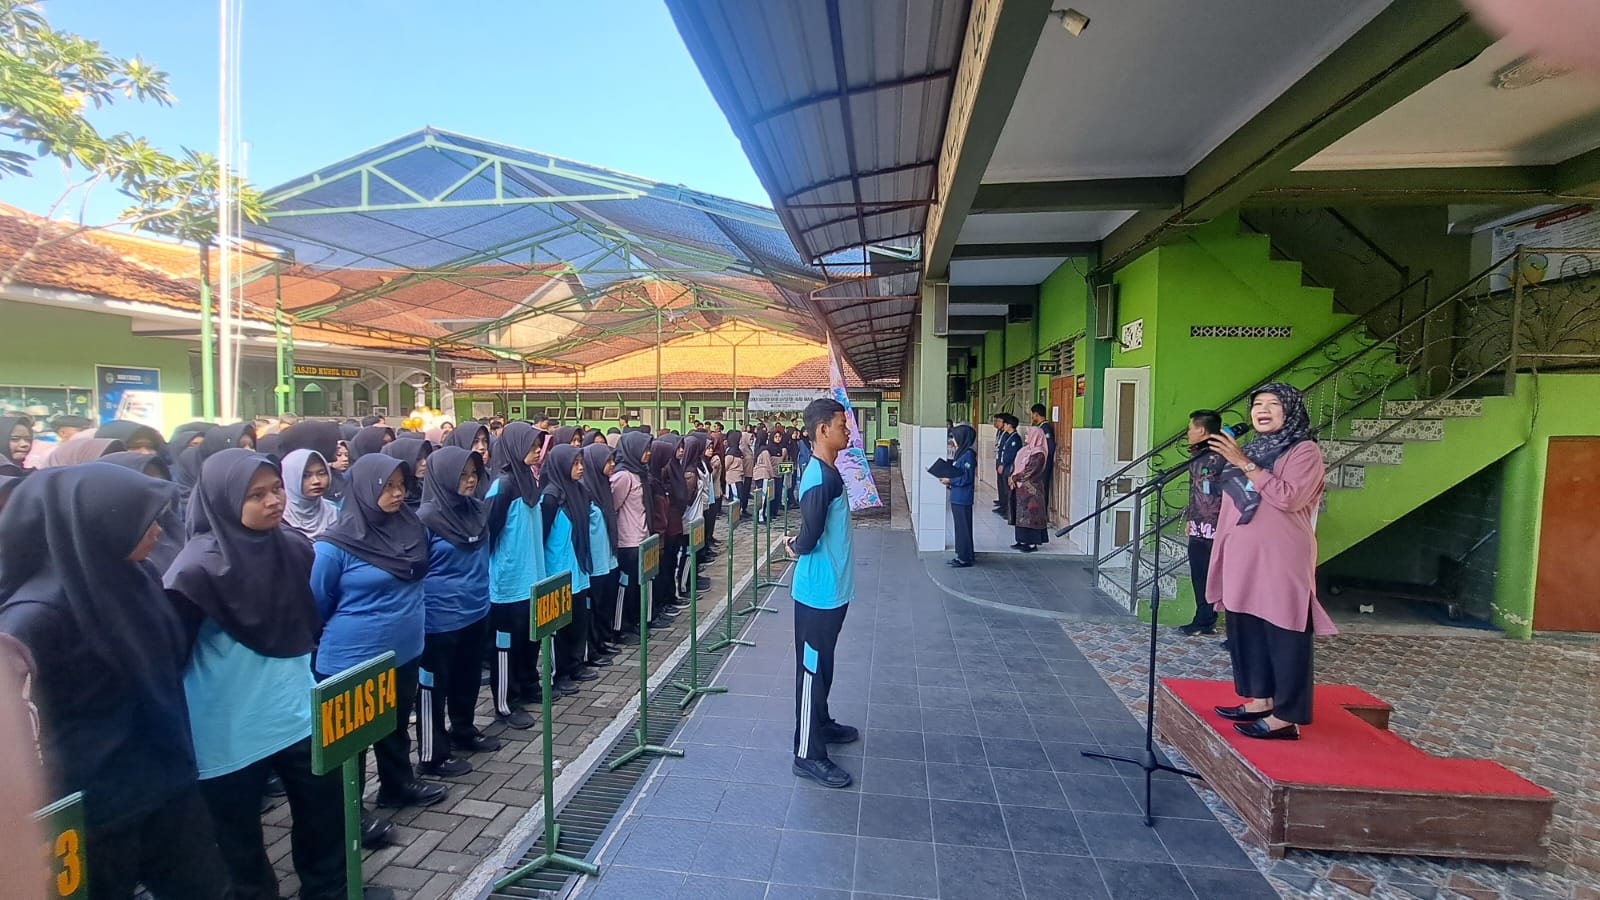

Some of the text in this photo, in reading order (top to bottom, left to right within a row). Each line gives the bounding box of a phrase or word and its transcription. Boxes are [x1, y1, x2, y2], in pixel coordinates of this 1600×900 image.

[537, 583, 572, 627] KELAS F5
[321, 667, 397, 748] KELAS F4
